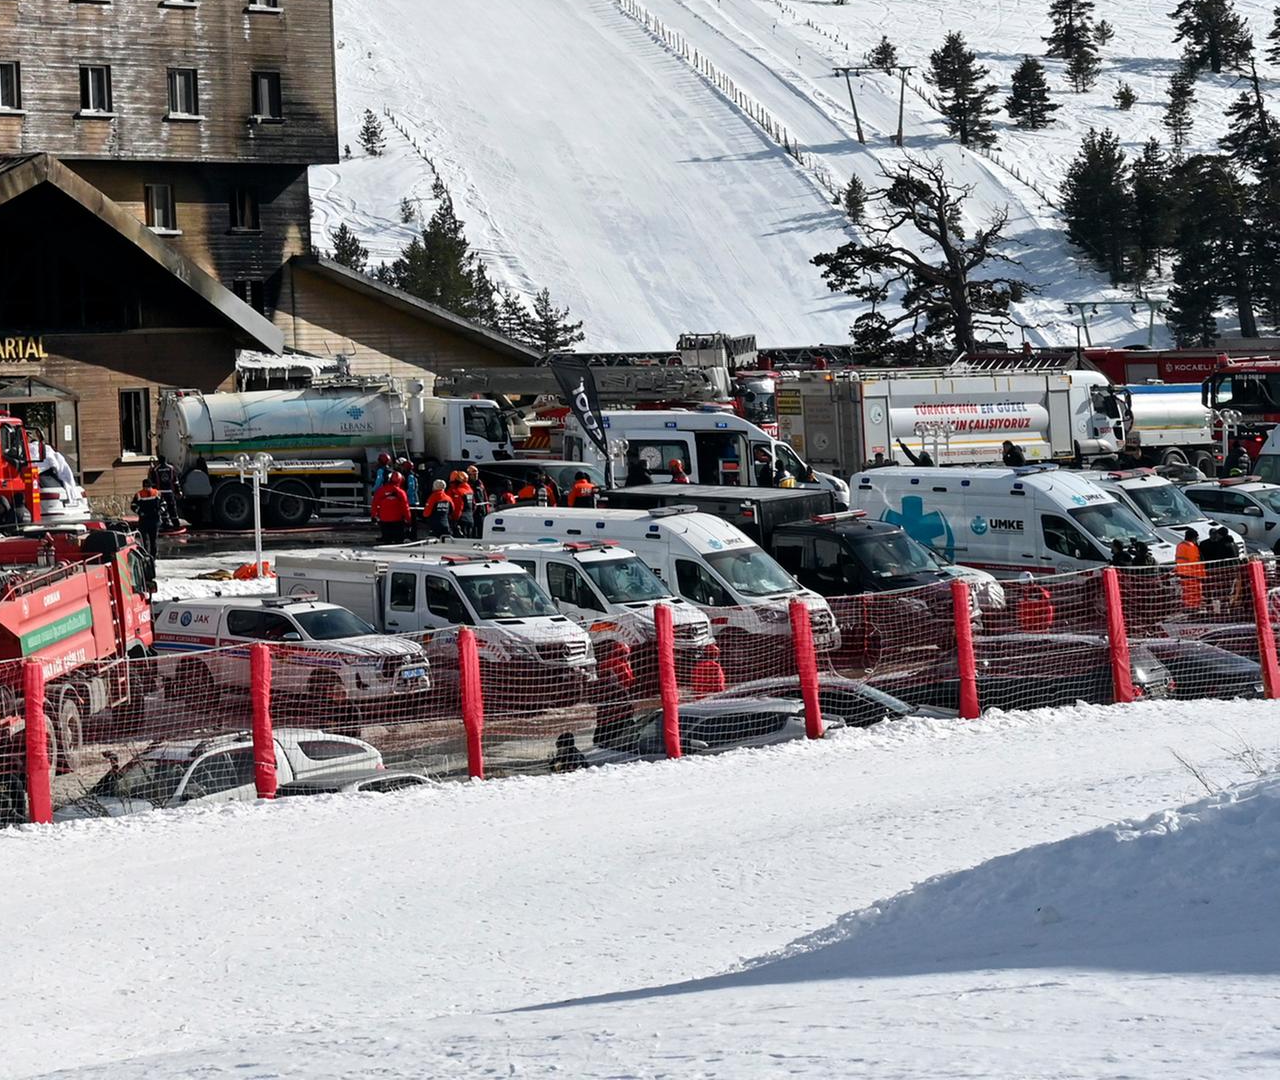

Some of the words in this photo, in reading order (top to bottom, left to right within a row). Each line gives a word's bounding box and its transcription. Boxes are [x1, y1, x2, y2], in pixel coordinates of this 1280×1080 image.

[981, 404, 994, 414] EN
[997, 399, 1027, 413] GÜZEL
[990, 519, 1024, 530] UMKE
[194, 614, 209, 624] JAK
